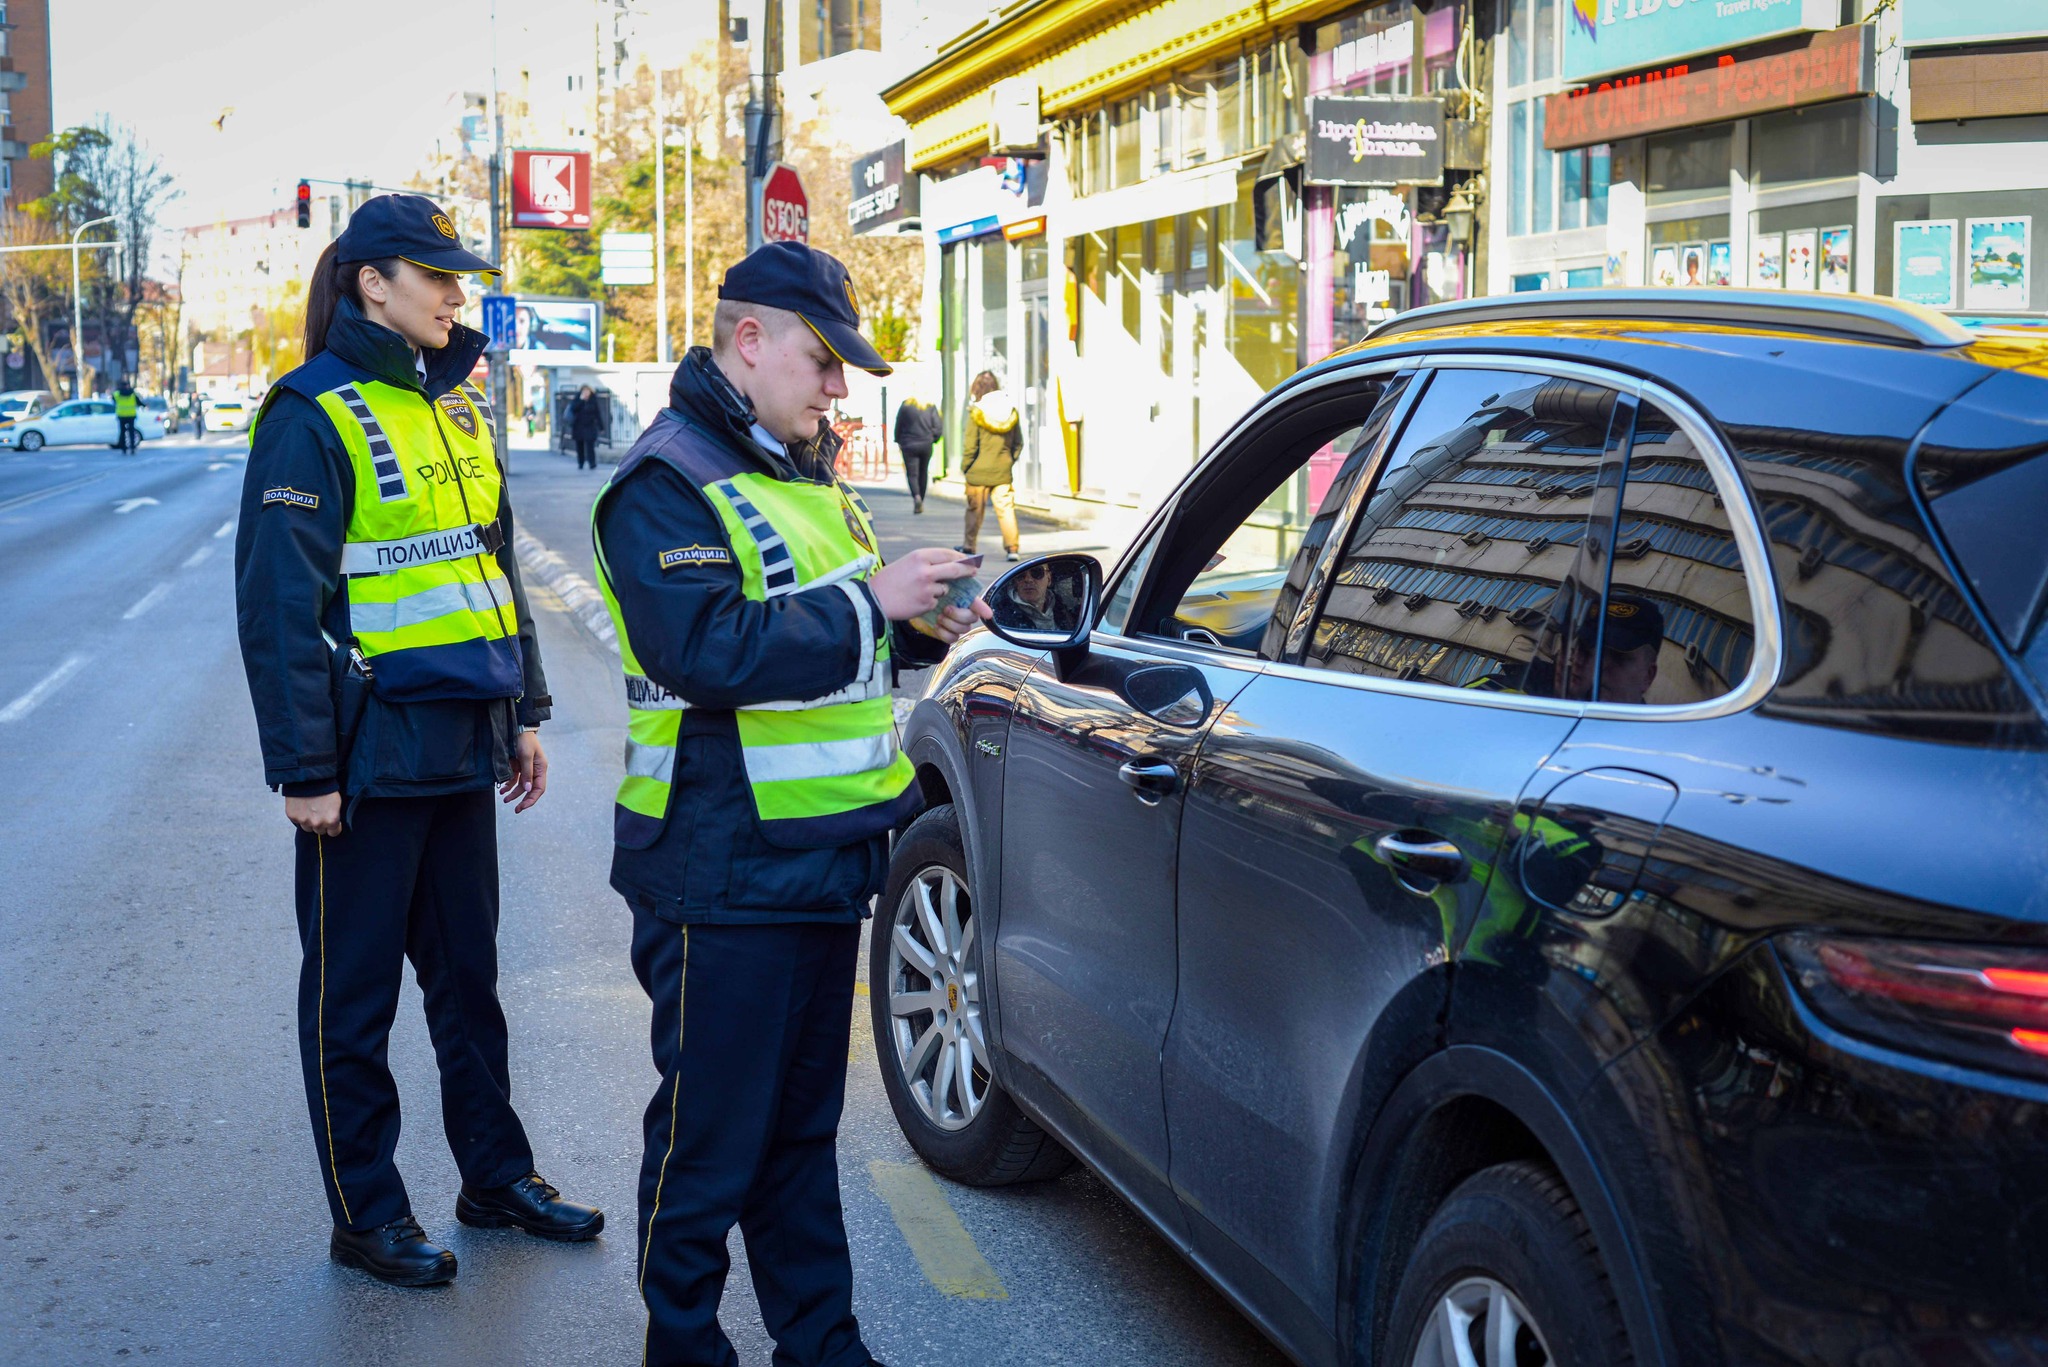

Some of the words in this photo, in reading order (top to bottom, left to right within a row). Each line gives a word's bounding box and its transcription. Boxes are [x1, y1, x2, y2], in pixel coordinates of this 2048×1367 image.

[1715, 0, 1750, 18] Travel
[1594, 65, 1688, 130] ONLINE
[766, 198, 805, 236] STOP
[416, 456, 485, 485] POLCE
[265, 492, 315, 506] ПОЛИЦИЈА
[665, 549, 727, 563] ПОЛИЦИЈА
